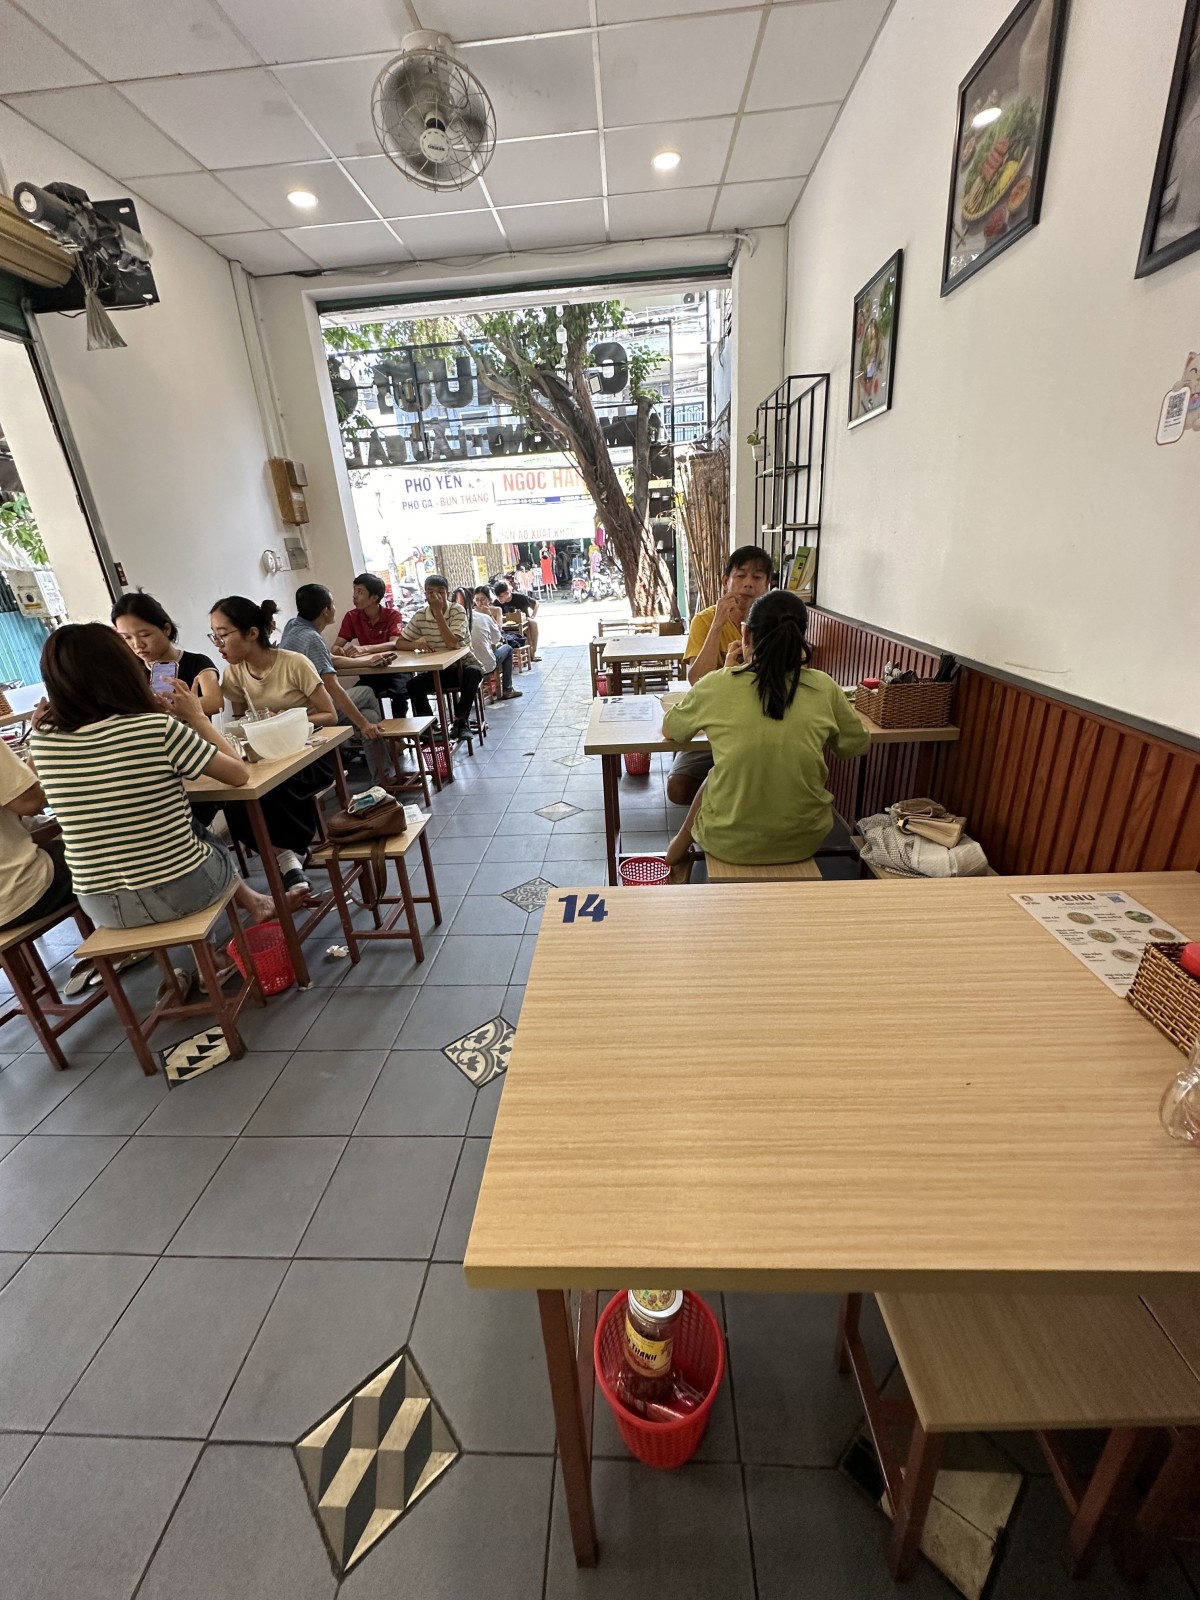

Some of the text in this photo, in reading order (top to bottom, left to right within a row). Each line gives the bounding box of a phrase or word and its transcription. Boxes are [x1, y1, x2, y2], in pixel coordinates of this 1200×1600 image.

[502, 471, 547, 495] NGỌC
[558, 894, 608, 923] 14
[1048, 894, 1096, 902] MENU
